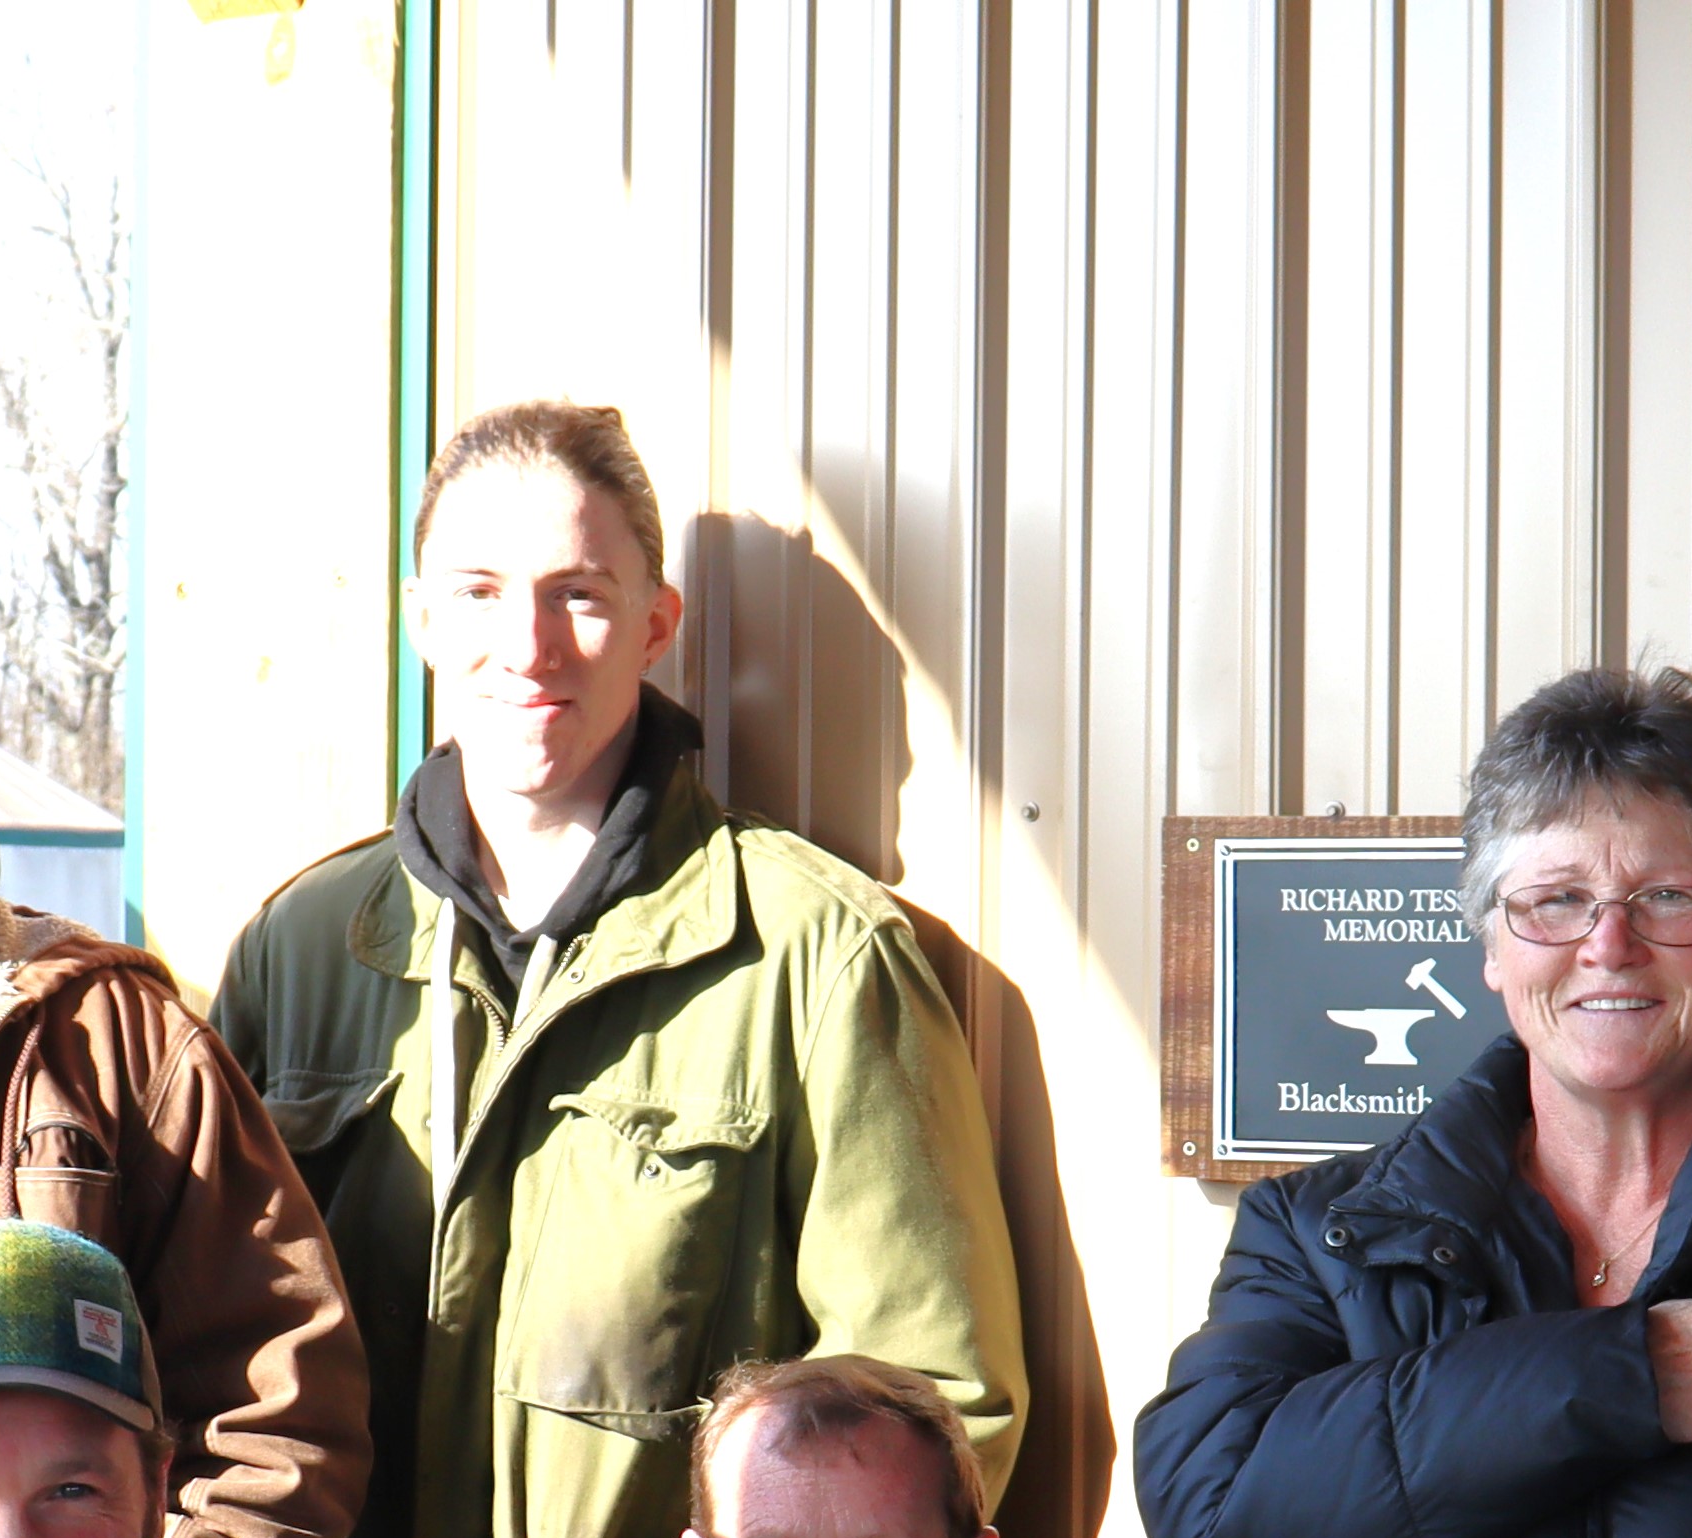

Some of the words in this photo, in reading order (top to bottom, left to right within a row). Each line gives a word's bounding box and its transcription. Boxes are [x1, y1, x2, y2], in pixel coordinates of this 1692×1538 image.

[1280, 888, 1405, 912] RICHARD
[1323, 918, 1472, 943] MEMORIAL
[1277, 1081, 1433, 1115] Blacksmith
